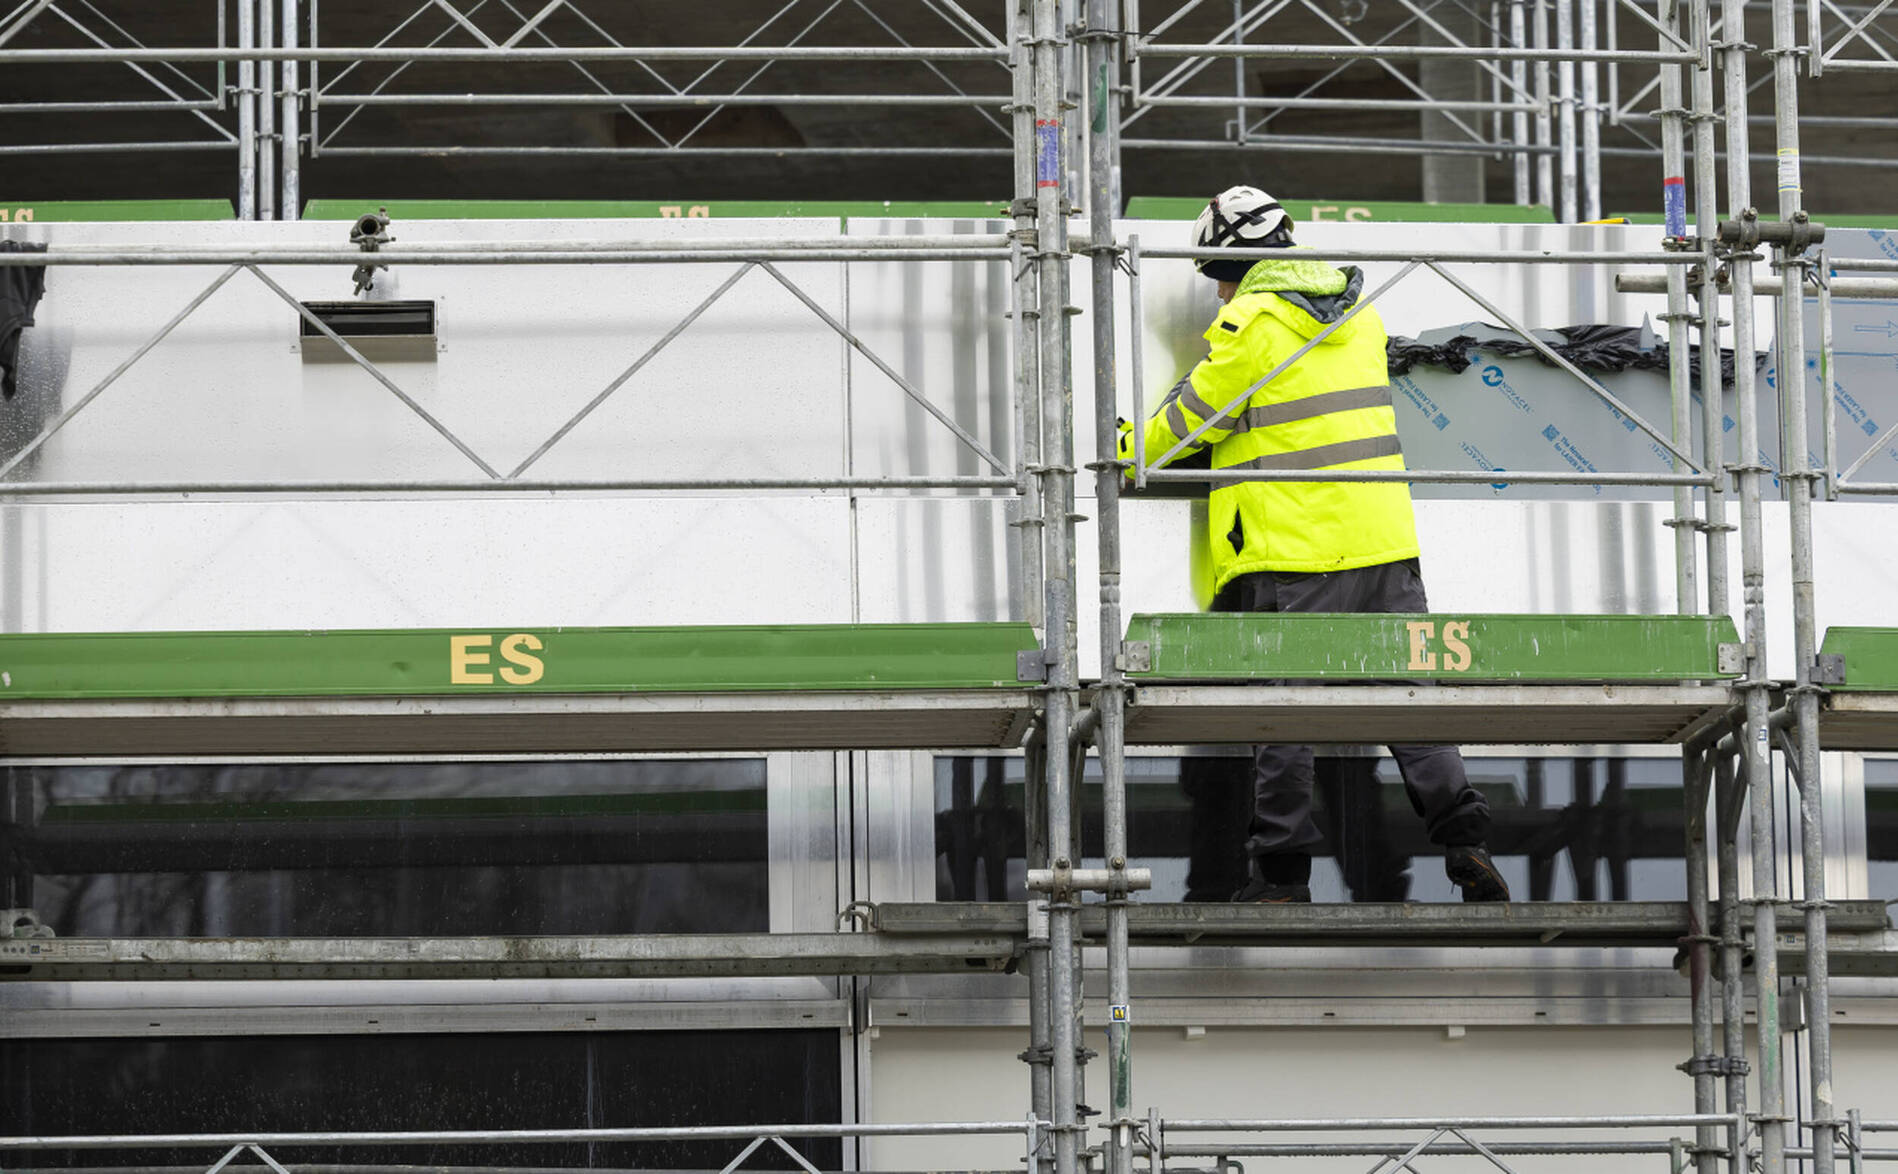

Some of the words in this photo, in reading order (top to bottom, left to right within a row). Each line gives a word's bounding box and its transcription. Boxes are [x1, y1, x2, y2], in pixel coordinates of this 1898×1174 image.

[1502, 381, 1530, 412] NOVACEL
[450, 633, 544, 685] ES
[1406, 621, 1472, 672] ES
